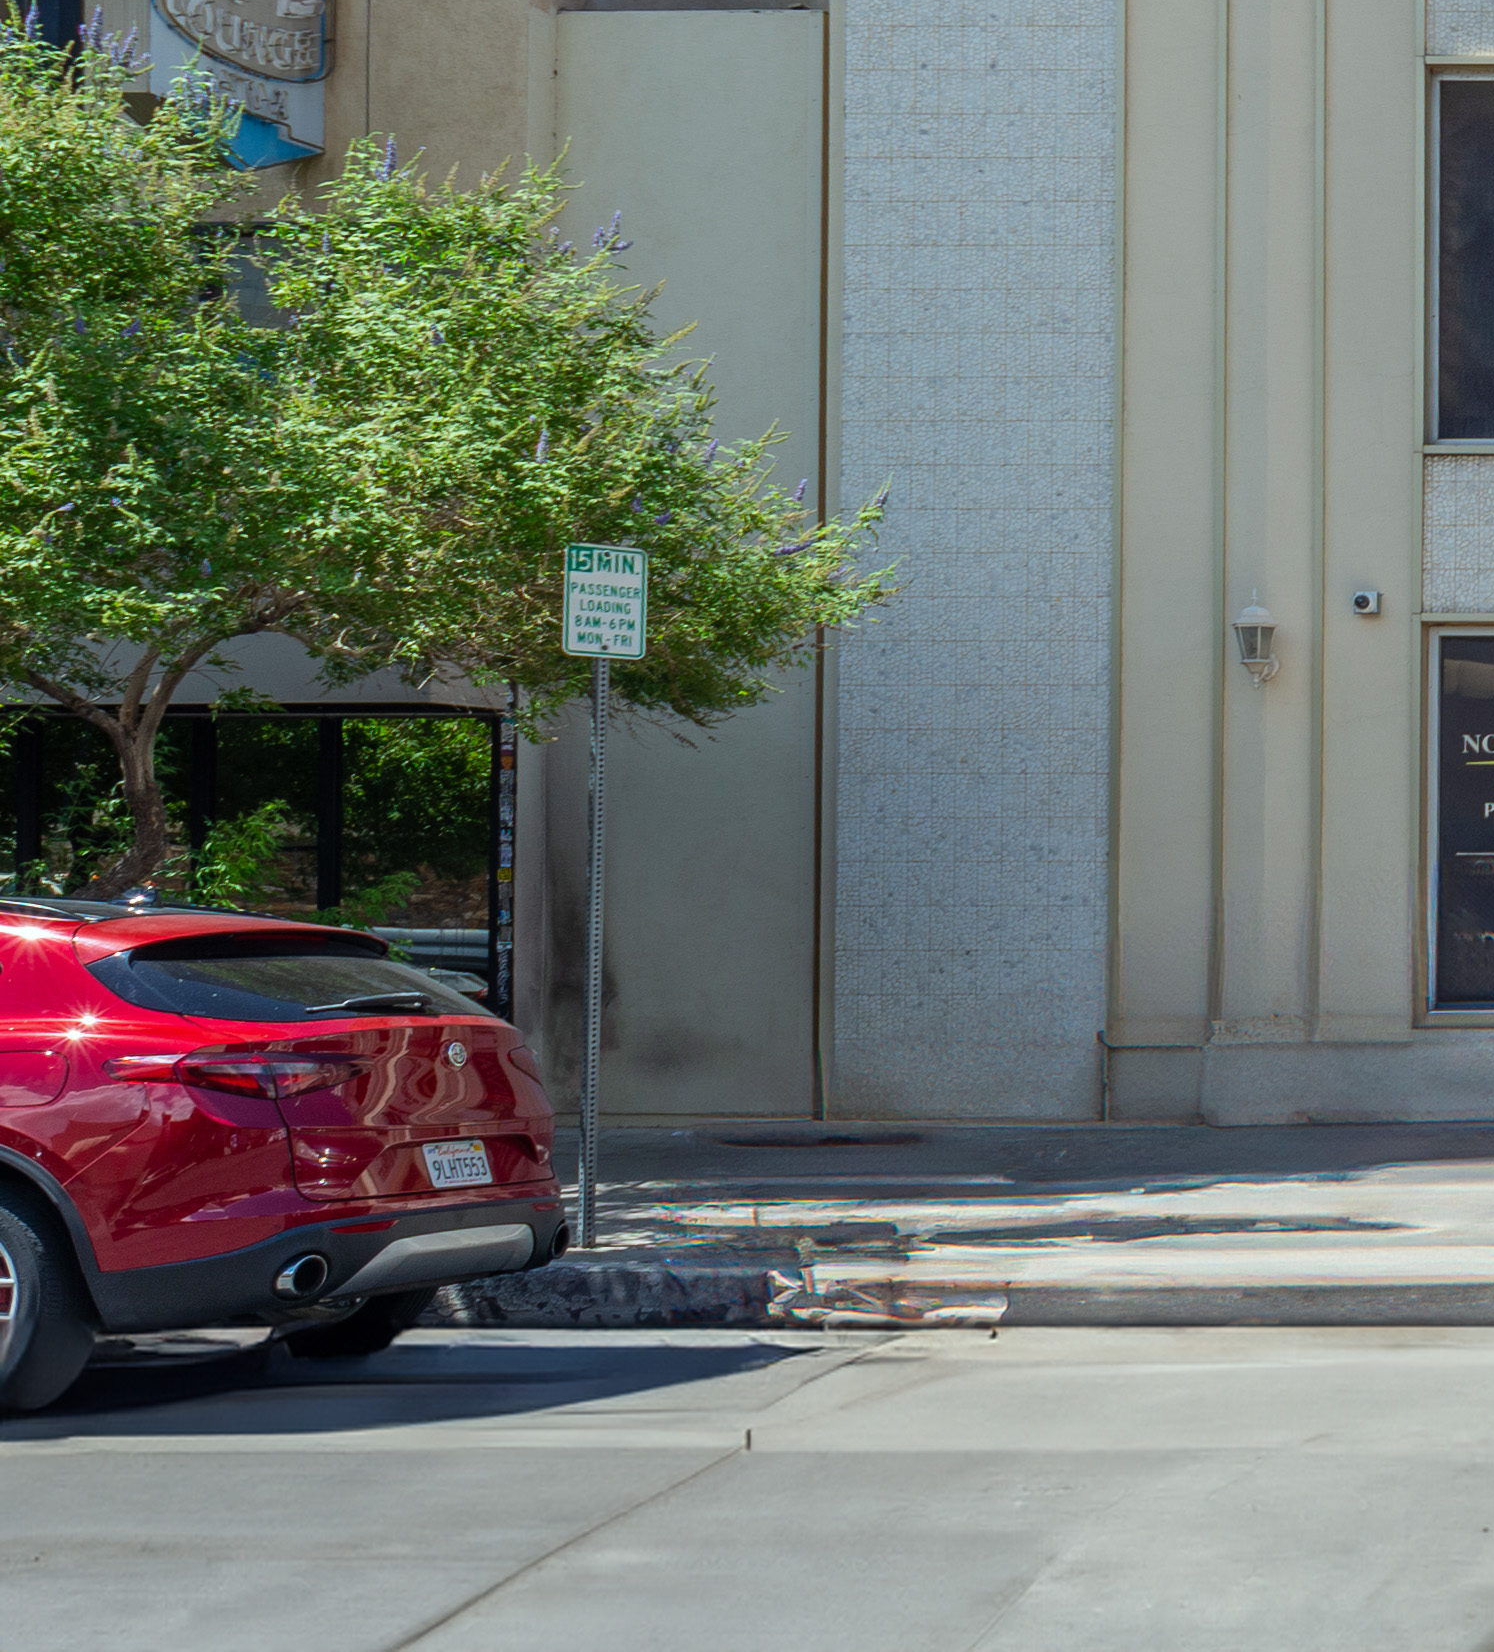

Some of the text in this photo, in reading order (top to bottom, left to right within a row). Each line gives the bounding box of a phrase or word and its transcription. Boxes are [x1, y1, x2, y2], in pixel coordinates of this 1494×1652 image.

[571, 549, 591, 571] 15
[571, 582, 641, 599] PASSENGER
[580, 599, 631, 615] LOADING
[577, 631, 632, 647] MON-FRI
[432, 1156, 488, 1180] 9LHT553
